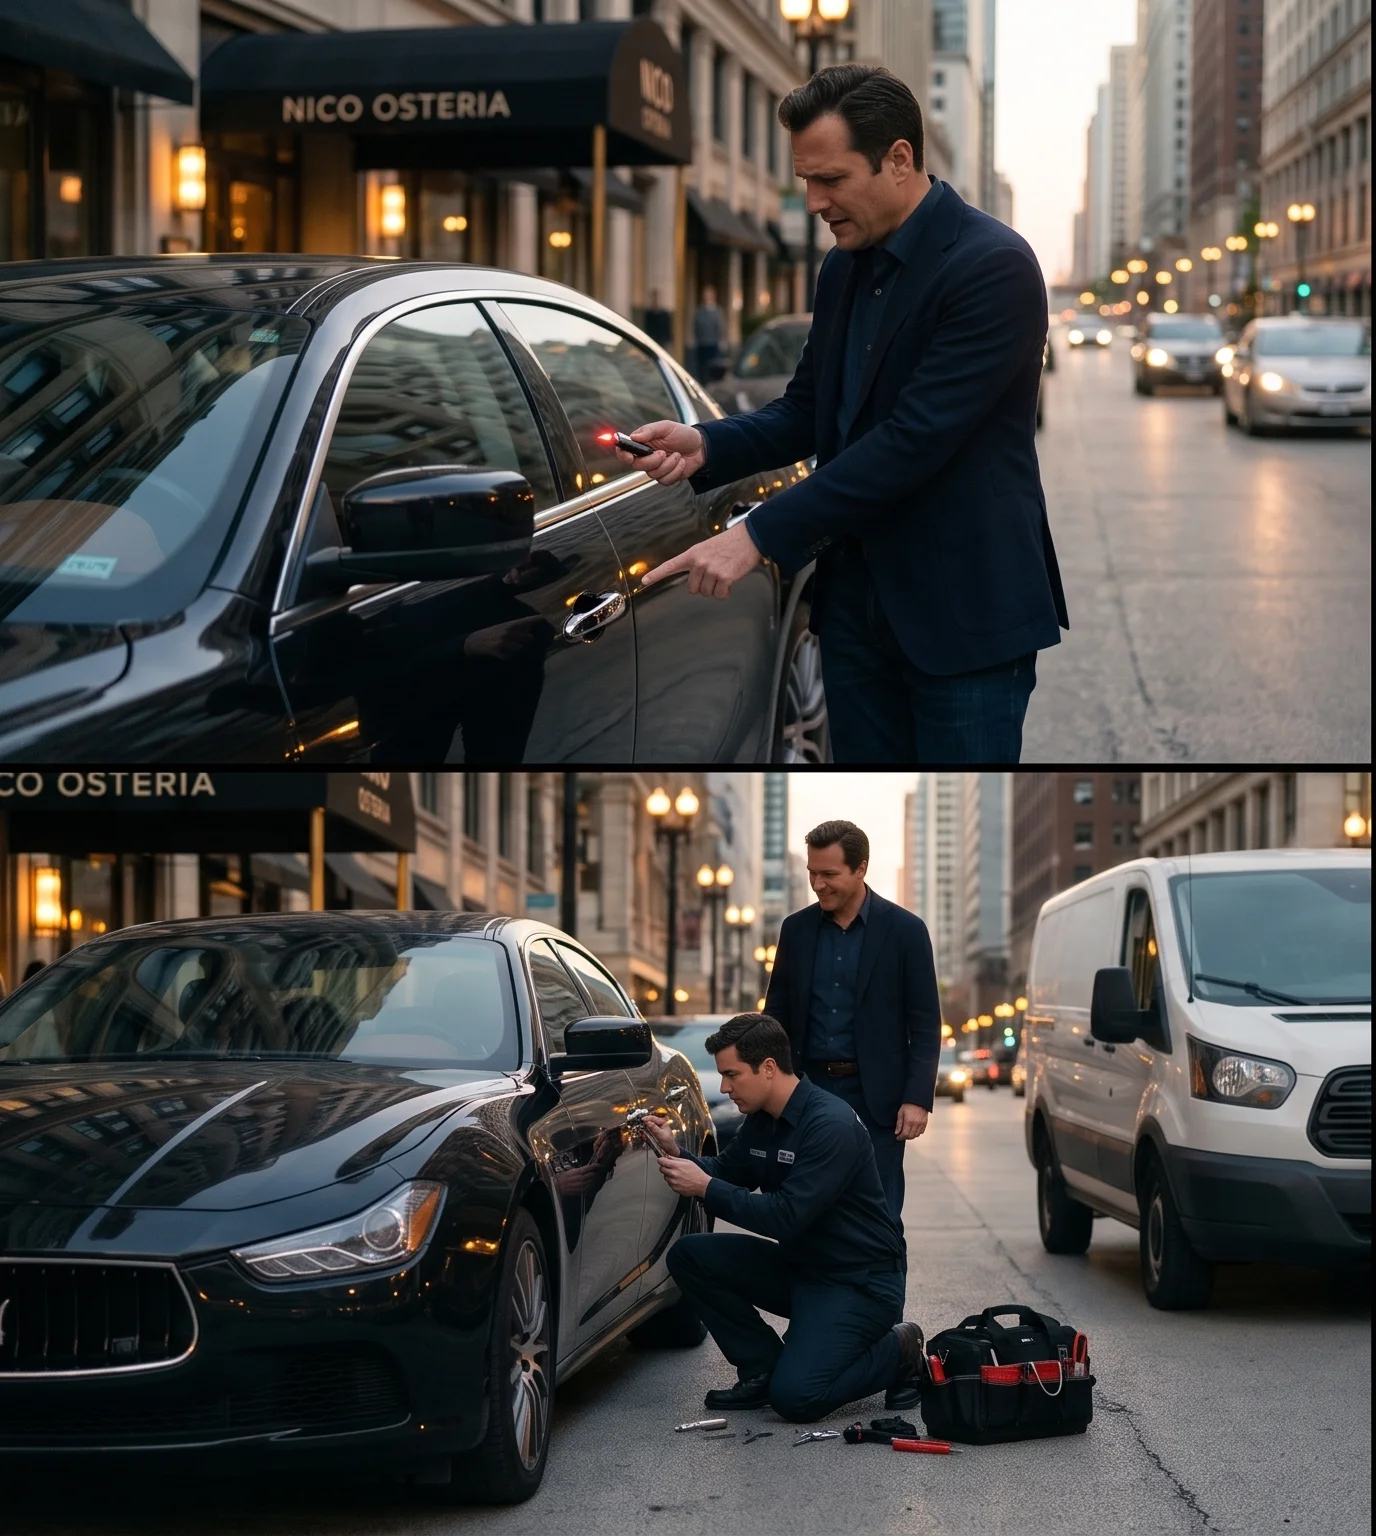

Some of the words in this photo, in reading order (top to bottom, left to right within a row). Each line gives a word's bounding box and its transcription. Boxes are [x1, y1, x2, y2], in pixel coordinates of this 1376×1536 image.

[282, 94, 364, 123] NICO
[372, 90, 511, 121] OSTERIA
[57, 773, 216, 797] OSTERIA
